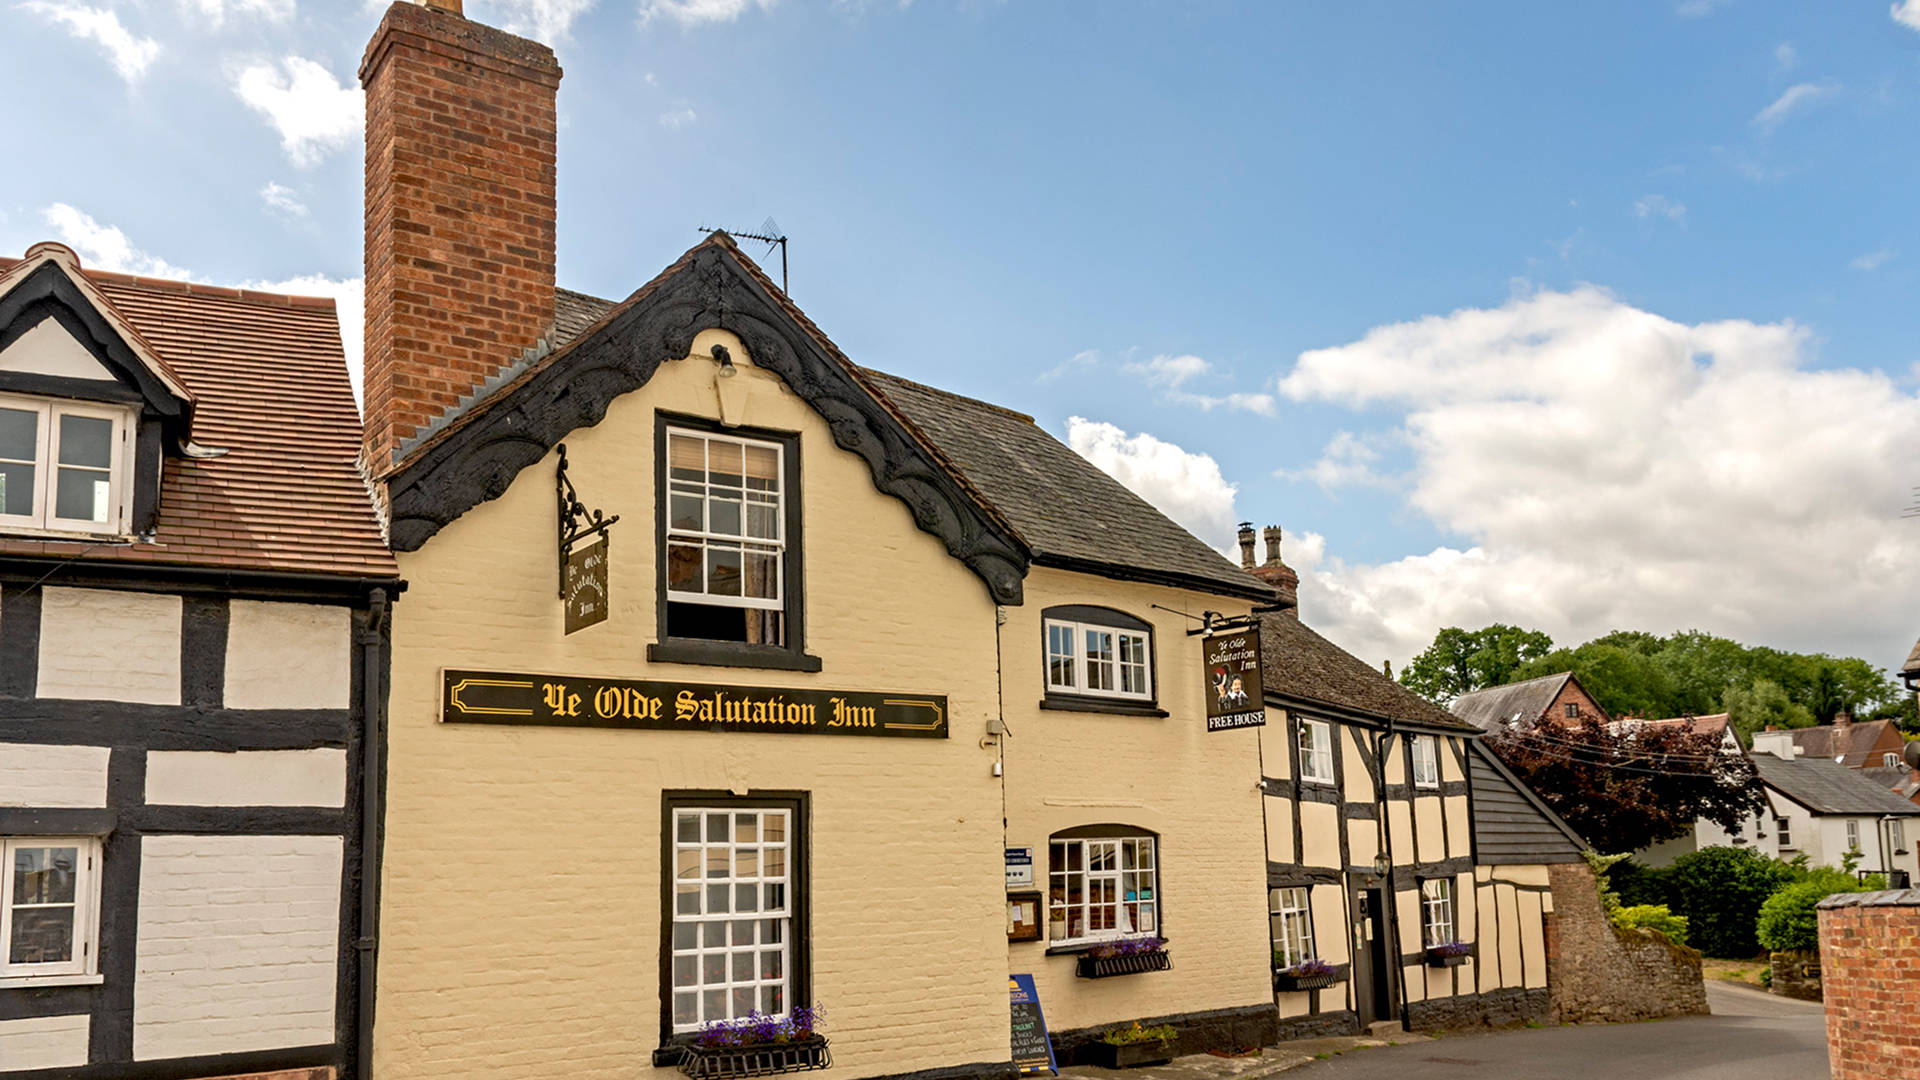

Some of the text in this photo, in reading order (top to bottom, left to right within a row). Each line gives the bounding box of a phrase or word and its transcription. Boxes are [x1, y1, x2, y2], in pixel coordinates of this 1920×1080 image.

[1219, 638, 1246, 651] Ye Olde
[1209, 649, 1255, 665] Salutation
[1241, 661, 1256, 671] Inn
[542, 683, 876, 728] Ye Olde Salutation Inn
[1209, 711, 1265, 728] FREE HOUSE
